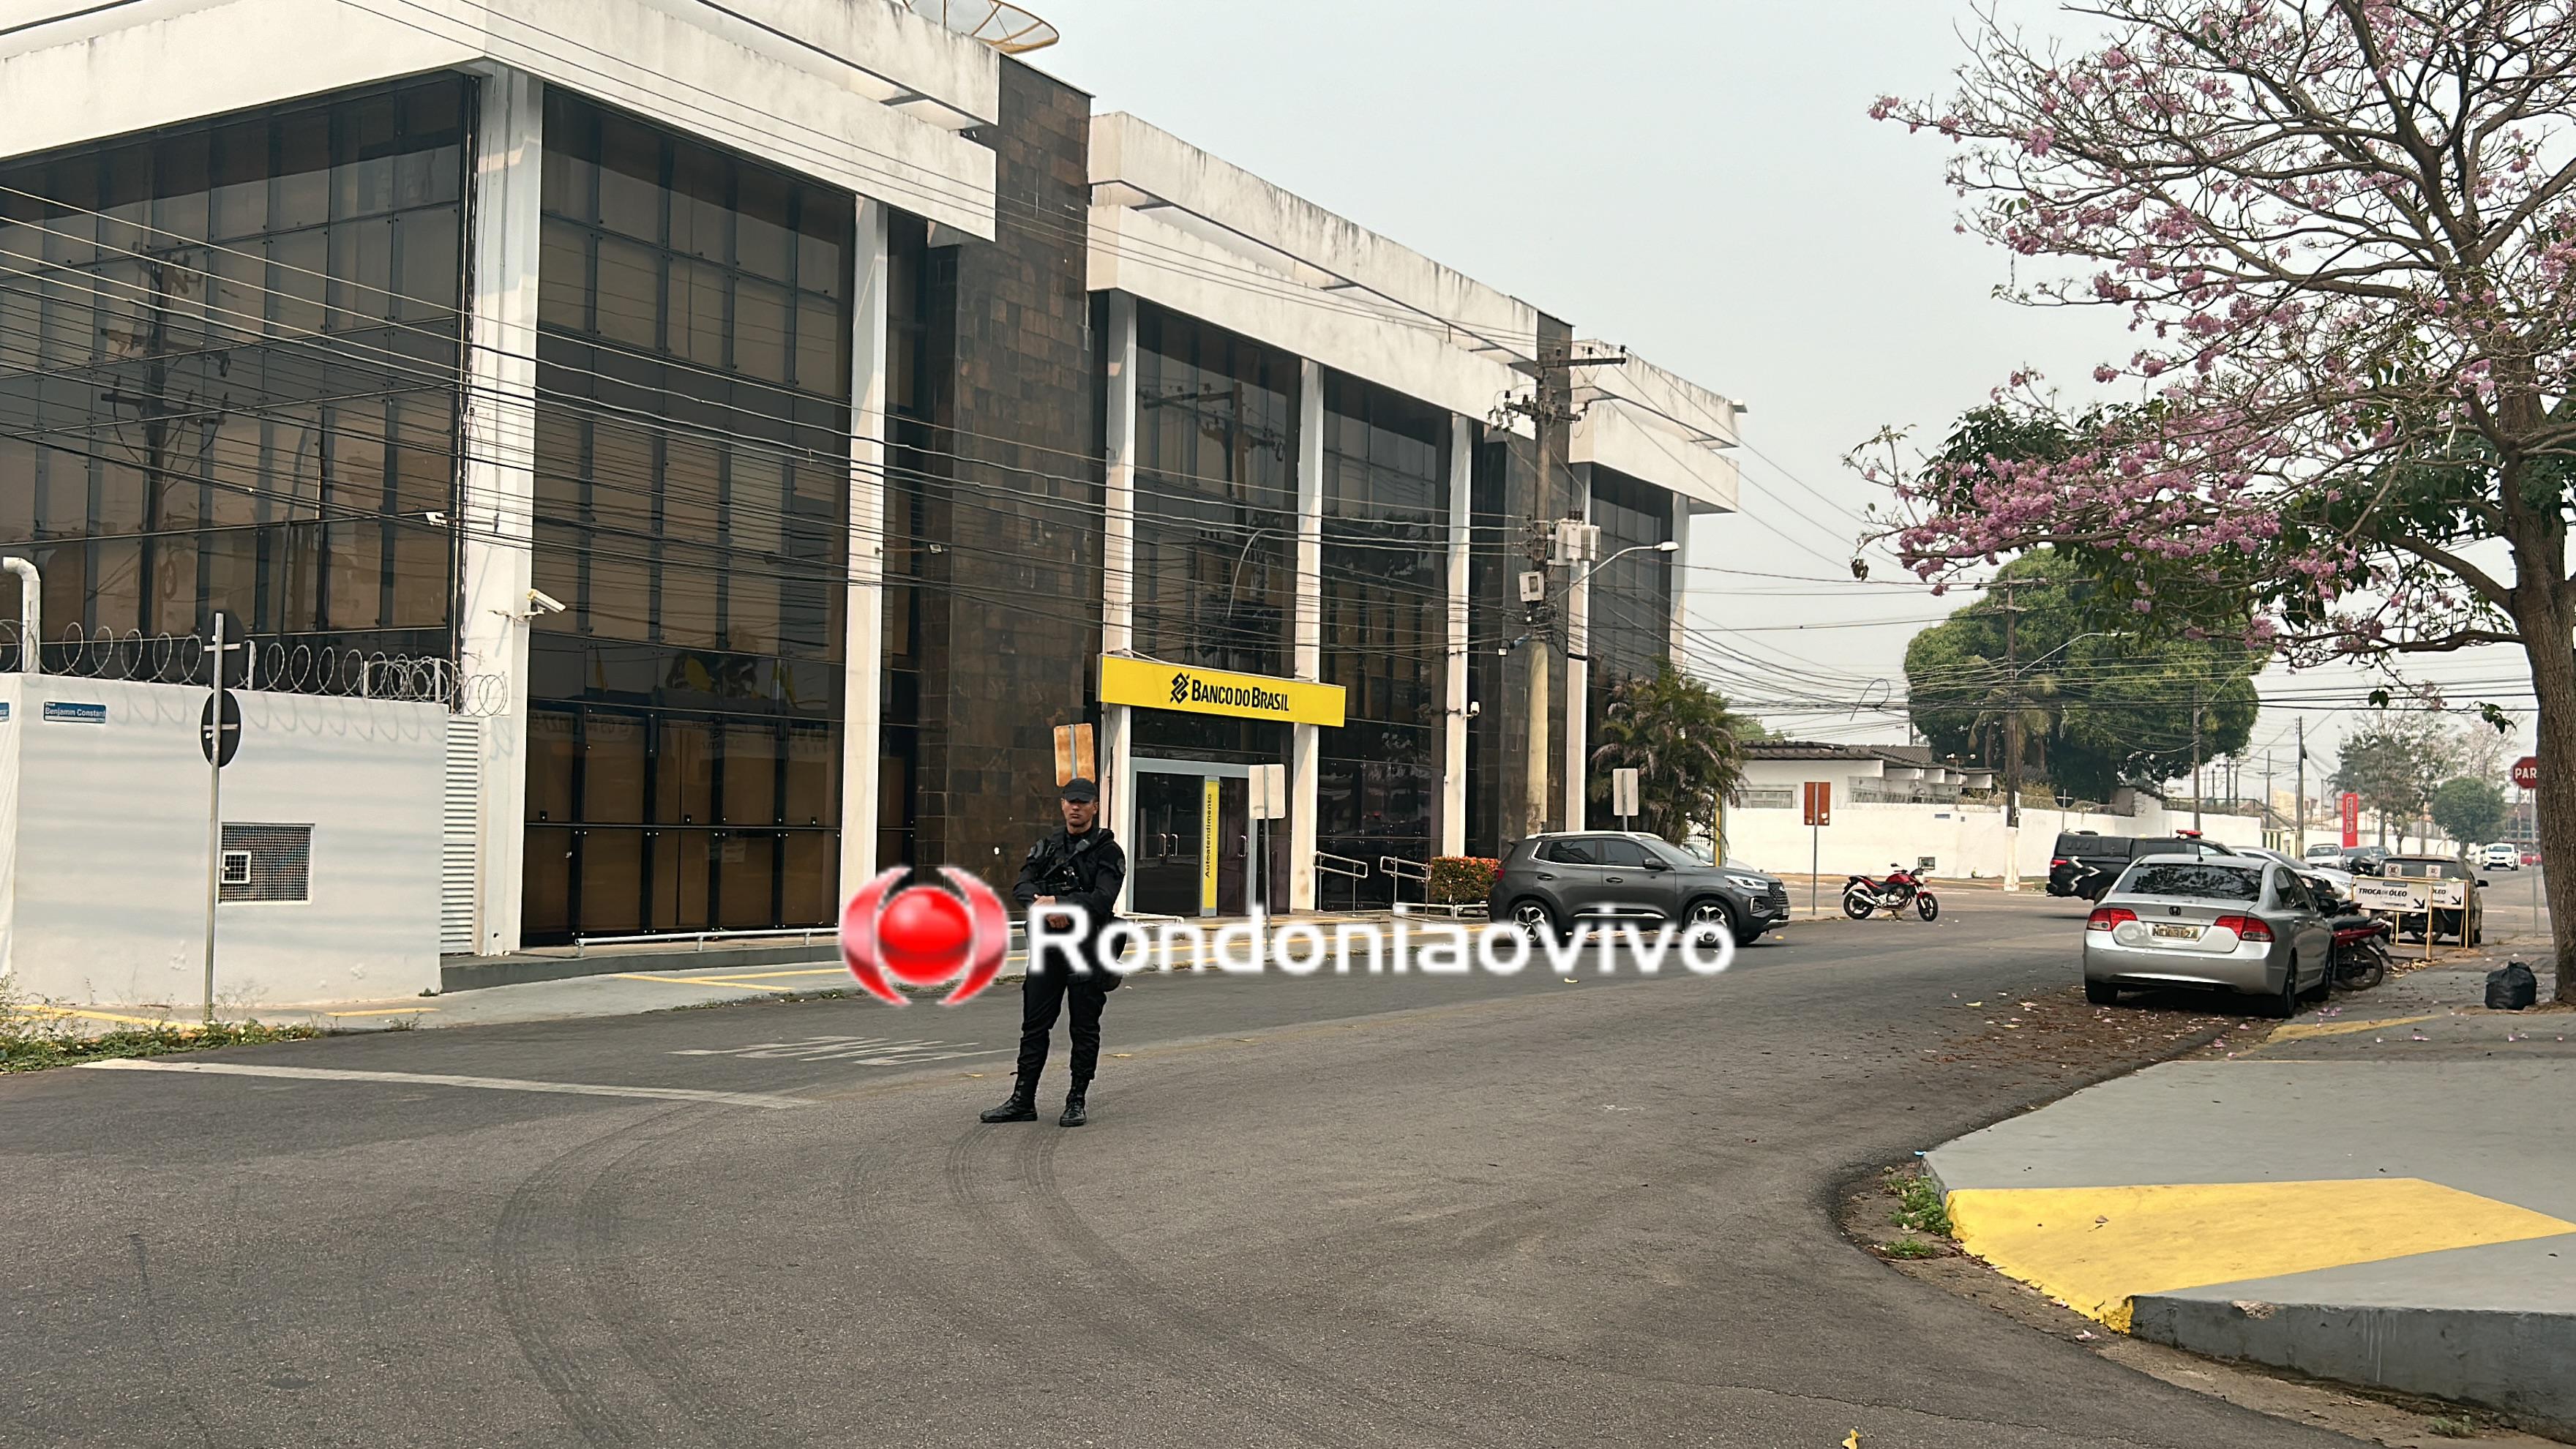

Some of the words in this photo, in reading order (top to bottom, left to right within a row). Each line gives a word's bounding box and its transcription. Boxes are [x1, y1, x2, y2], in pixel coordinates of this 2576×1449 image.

[1191, 679, 1233, 705] BANCO
[1235, 687, 1250, 707] DO
[1251, 686, 1289, 711] BRASIL
[45, 707, 75, 716] Benjamin
[76, 708, 105, 717] Constant
[2515, 767, 2537, 779] PAR
[2389, 888, 2408, 897] ÓLEO
